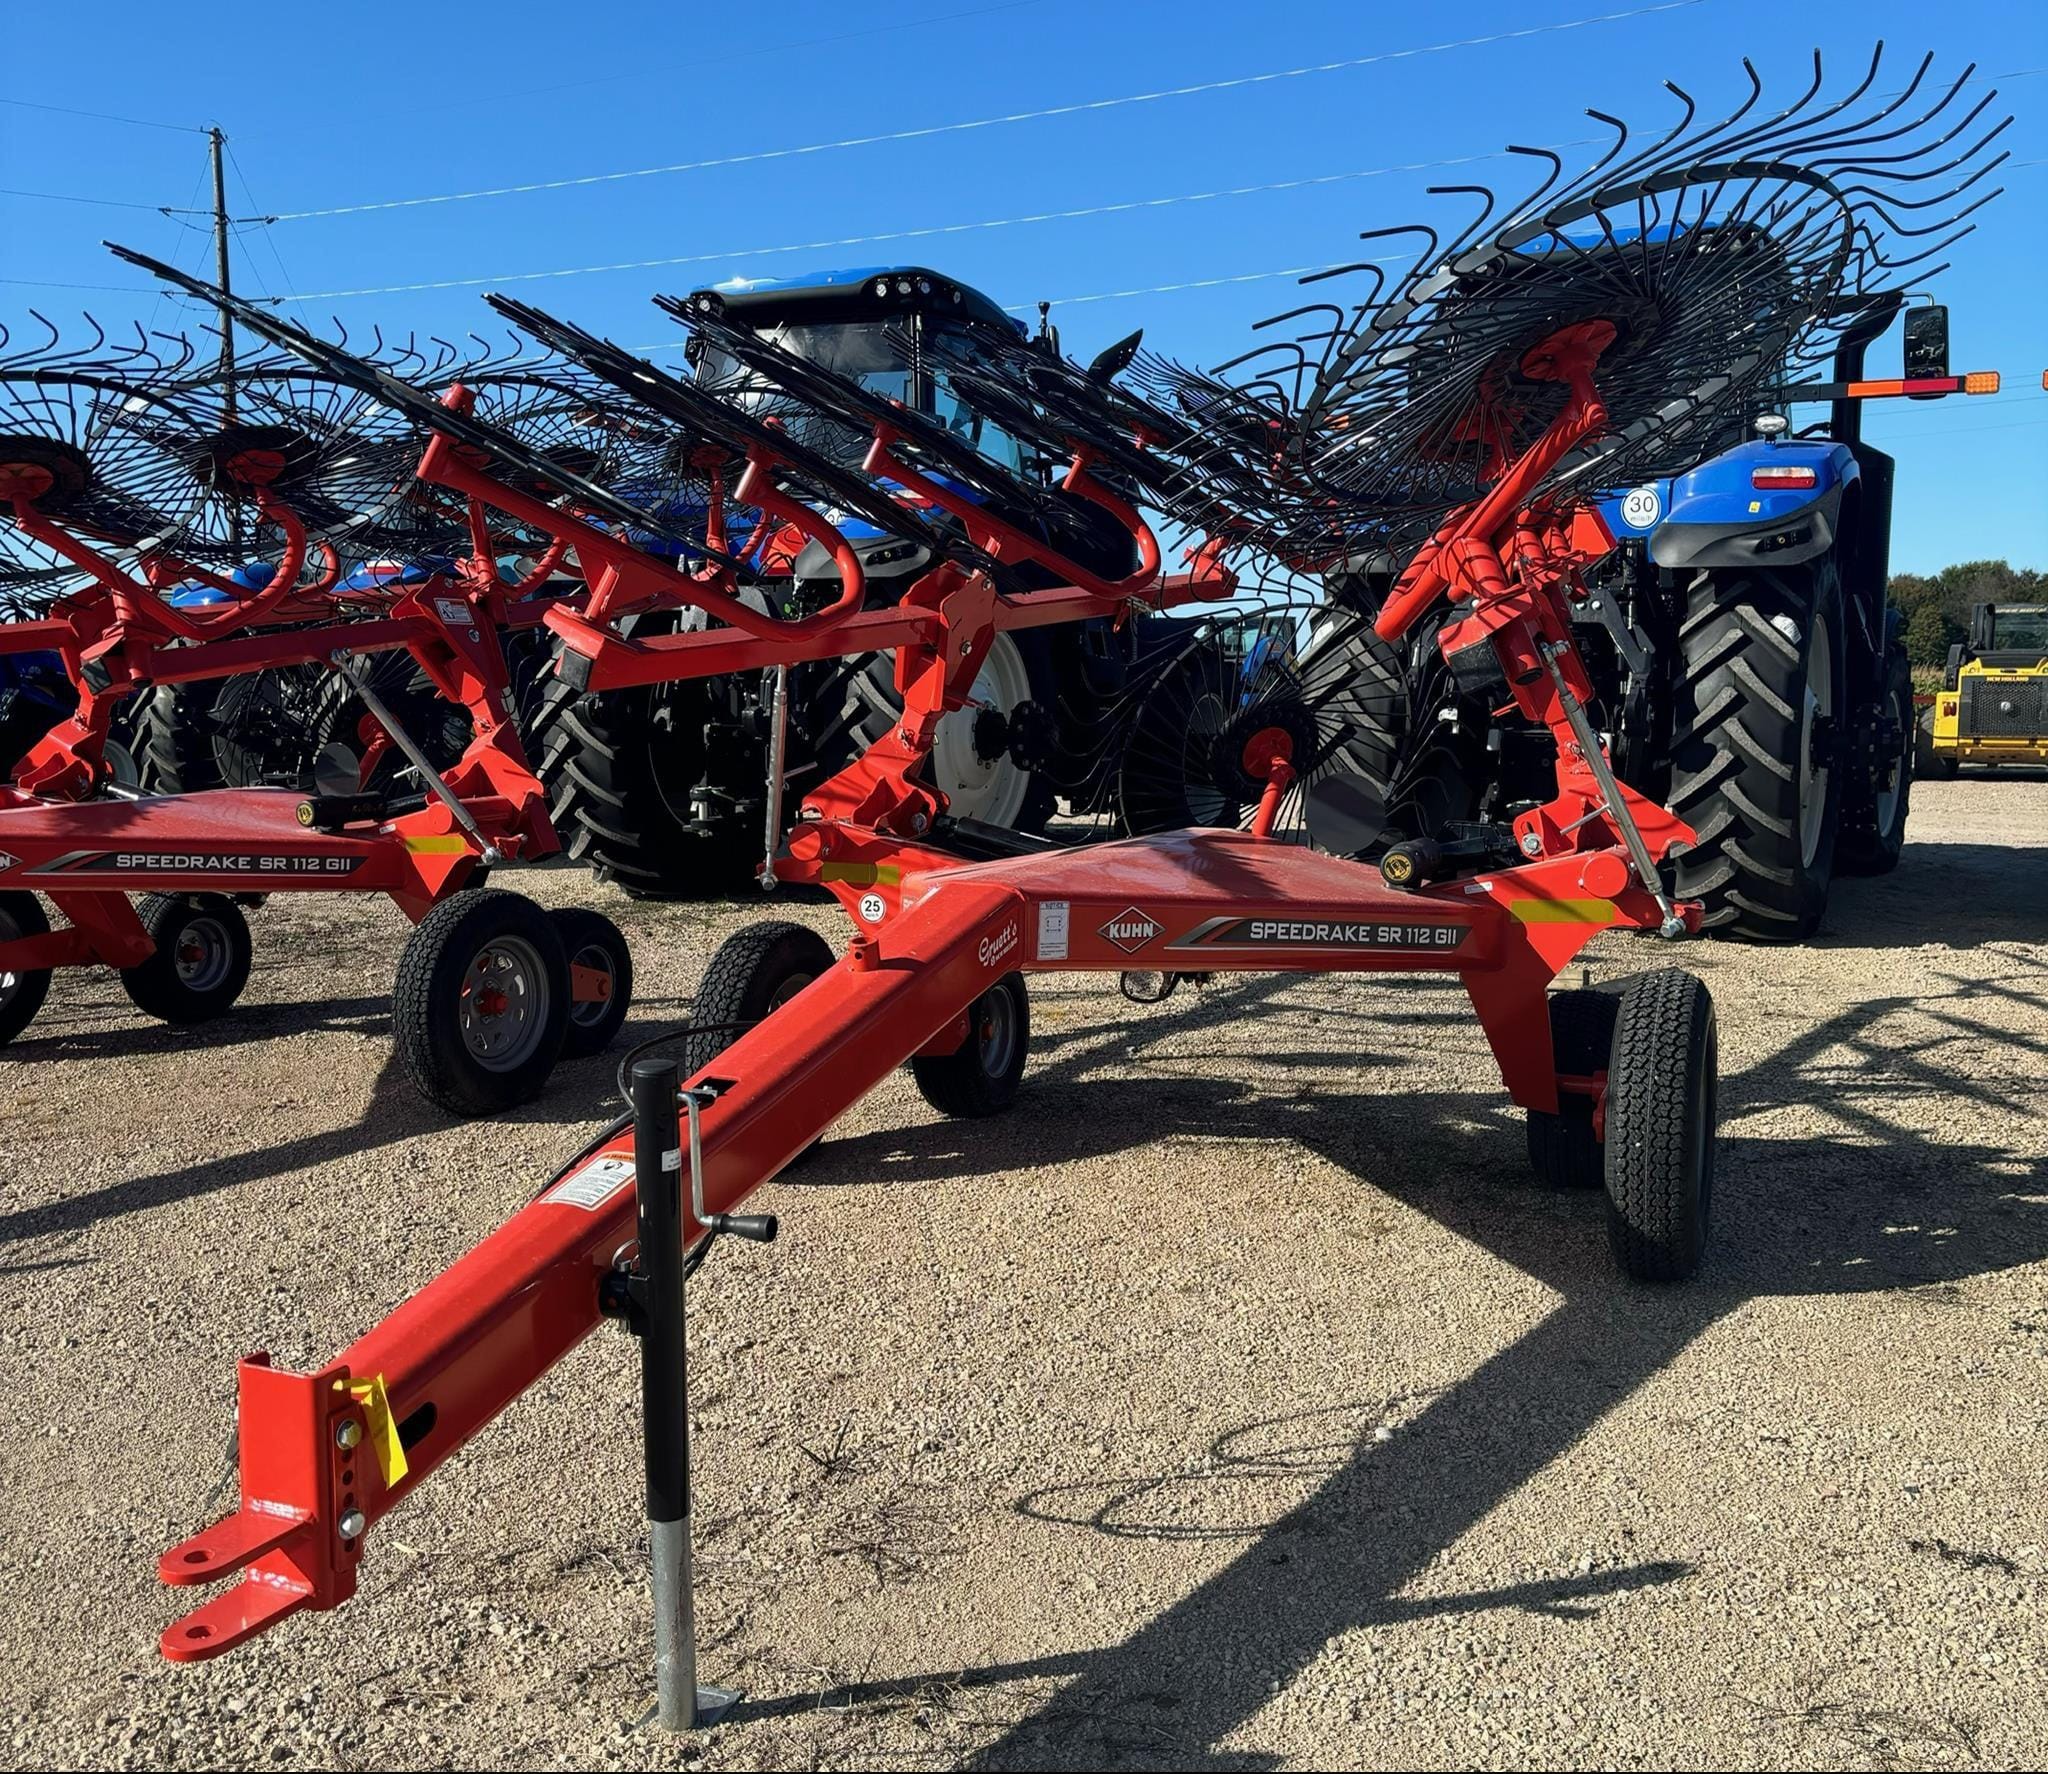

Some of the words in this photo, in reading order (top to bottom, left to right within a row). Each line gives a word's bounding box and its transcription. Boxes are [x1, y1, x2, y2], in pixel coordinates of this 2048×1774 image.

[1630, 496, 1654, 513] 30
[116, 854, 251, 870] SPEEDRAKE
[259, 857, 287, 870] SR
[292, 857, 320, 870] 112
[326, 858, 350, 871] GII
[864, 900, 881, 912] 25
[1109, 922, 1154, 939] KUHN
[1250, 921, 1371, 942] SPEEDRAKE
[1377, 926, 1402, 943] SR
[1406, 928, 1430, 944] 112
[1434, 928, 1457, 945] GII
[979, 919, 1018, 967] Gruett's
